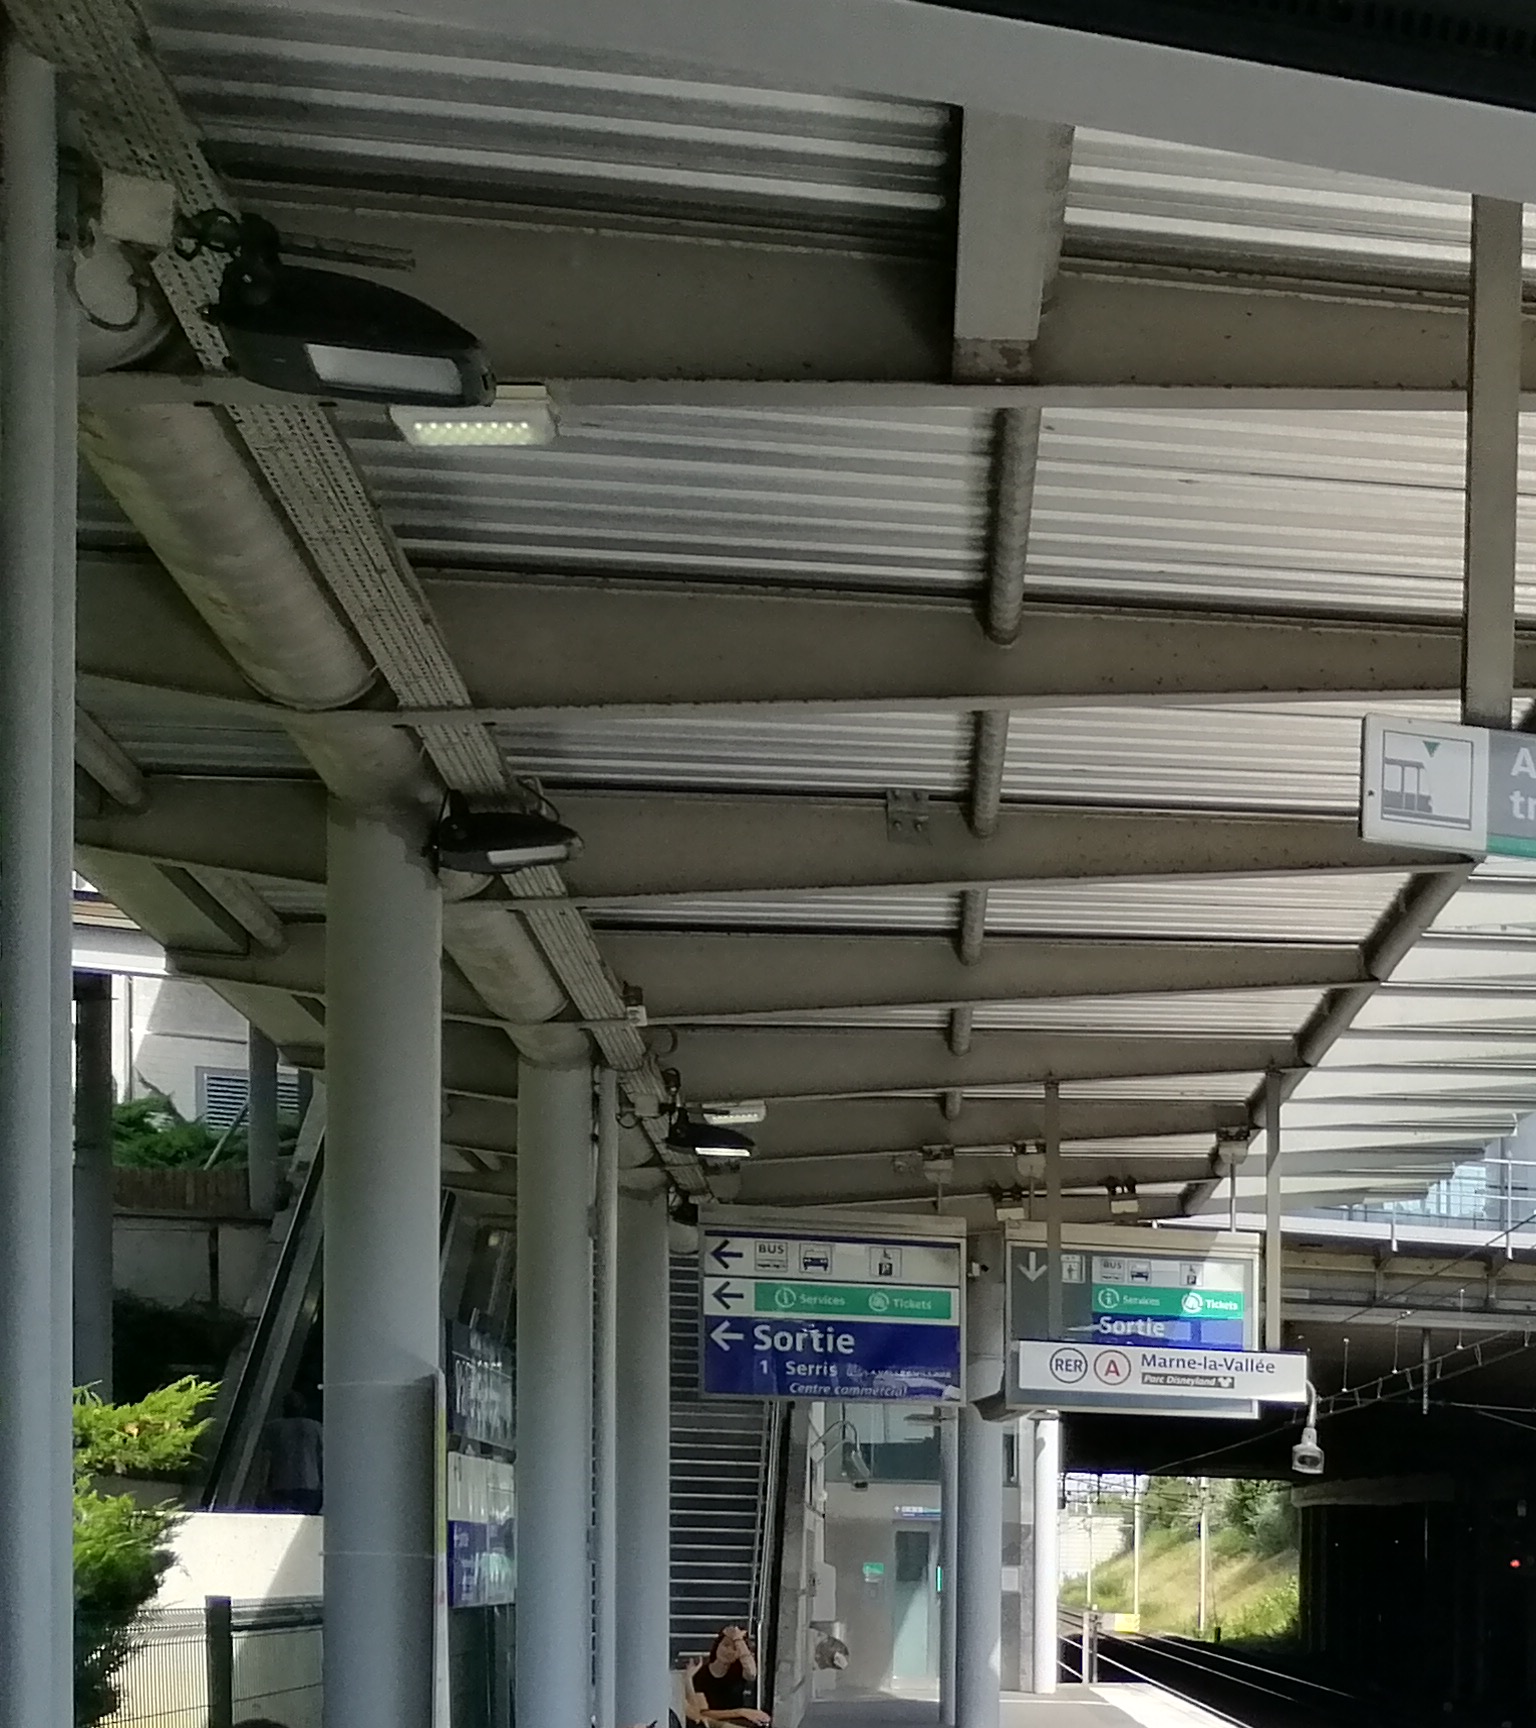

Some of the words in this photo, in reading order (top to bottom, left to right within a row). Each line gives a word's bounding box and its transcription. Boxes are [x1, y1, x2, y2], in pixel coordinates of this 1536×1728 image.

[758, 1243, 784, 1255] BUS
[799, 1293, 846, 1306] Services
[892, 1297, 933, 1311] Tickets
[1205, 1299, 1239, 1311] Tickets
[1098, 1315, 1166, 1338] Sortie
[753, 1323, 856, 1355] Sortie
[759, 1360, 769, 1375] 1
[785, 1360, 838, 1377] Serris
[1055, 1357, 1084, 1373] RER
[1104, 1359, 1121, 1378] A
[1141, 1352, 1277, 1375] Marne-la-Vallée
[1143, 1375, 1165, 1385] Parc
[1166, 1376, 1217, 1387] Disneyland
[789, 1382, 831, 1394] Centre
[833, 1384, 908, 1398] commercial
